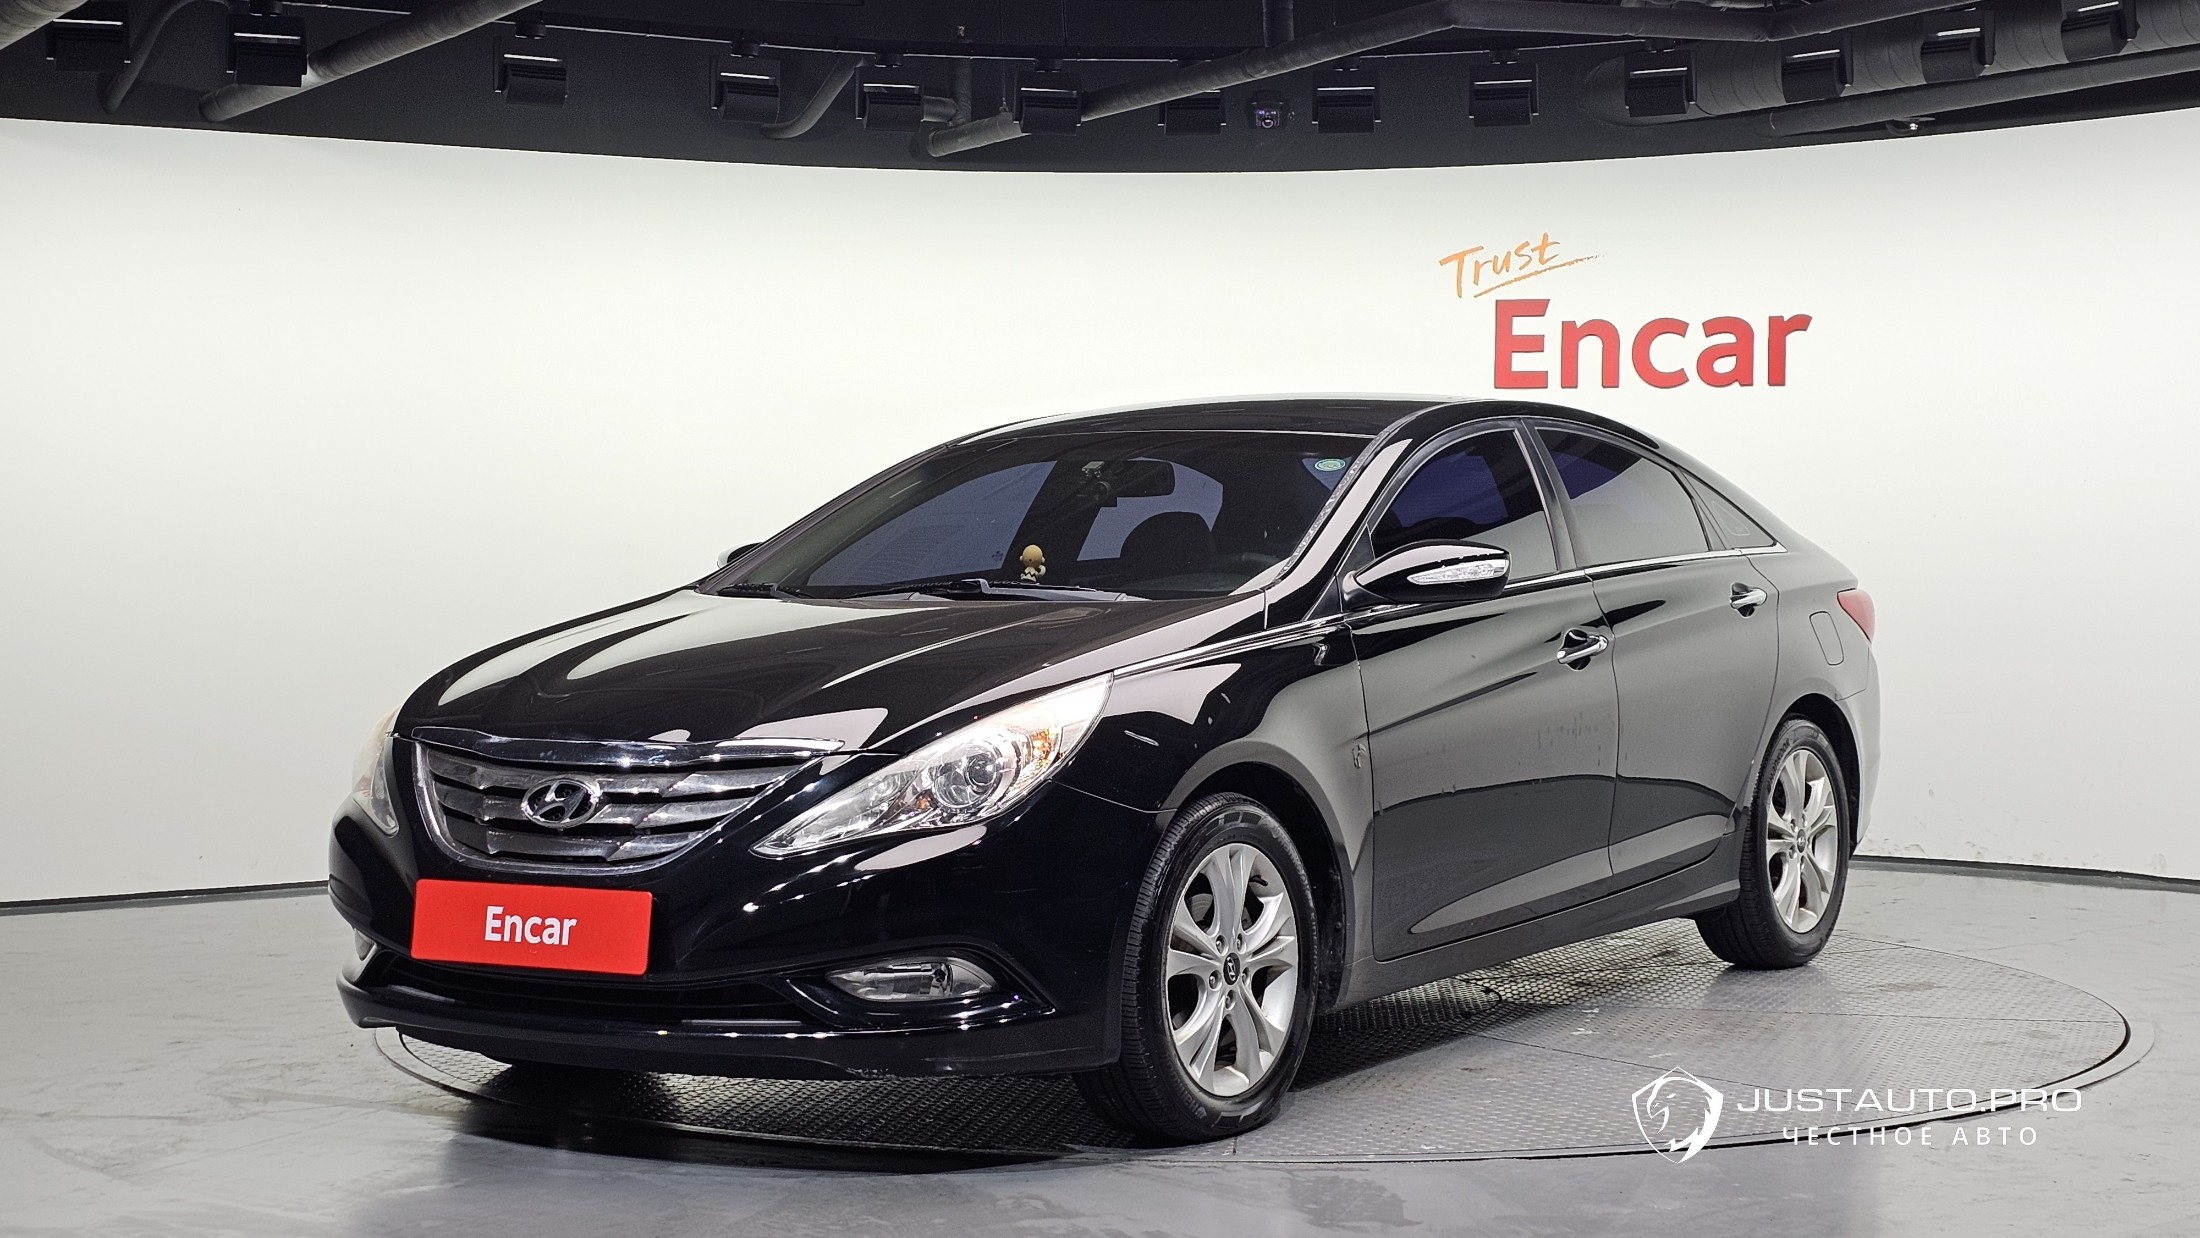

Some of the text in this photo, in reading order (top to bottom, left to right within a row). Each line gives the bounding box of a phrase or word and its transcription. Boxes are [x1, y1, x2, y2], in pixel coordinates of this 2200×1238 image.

[1439, 232, 1561, 299] Trust
[1494, 299, 1812, 389] Encar
[484, 905, 578, 946] Encar
